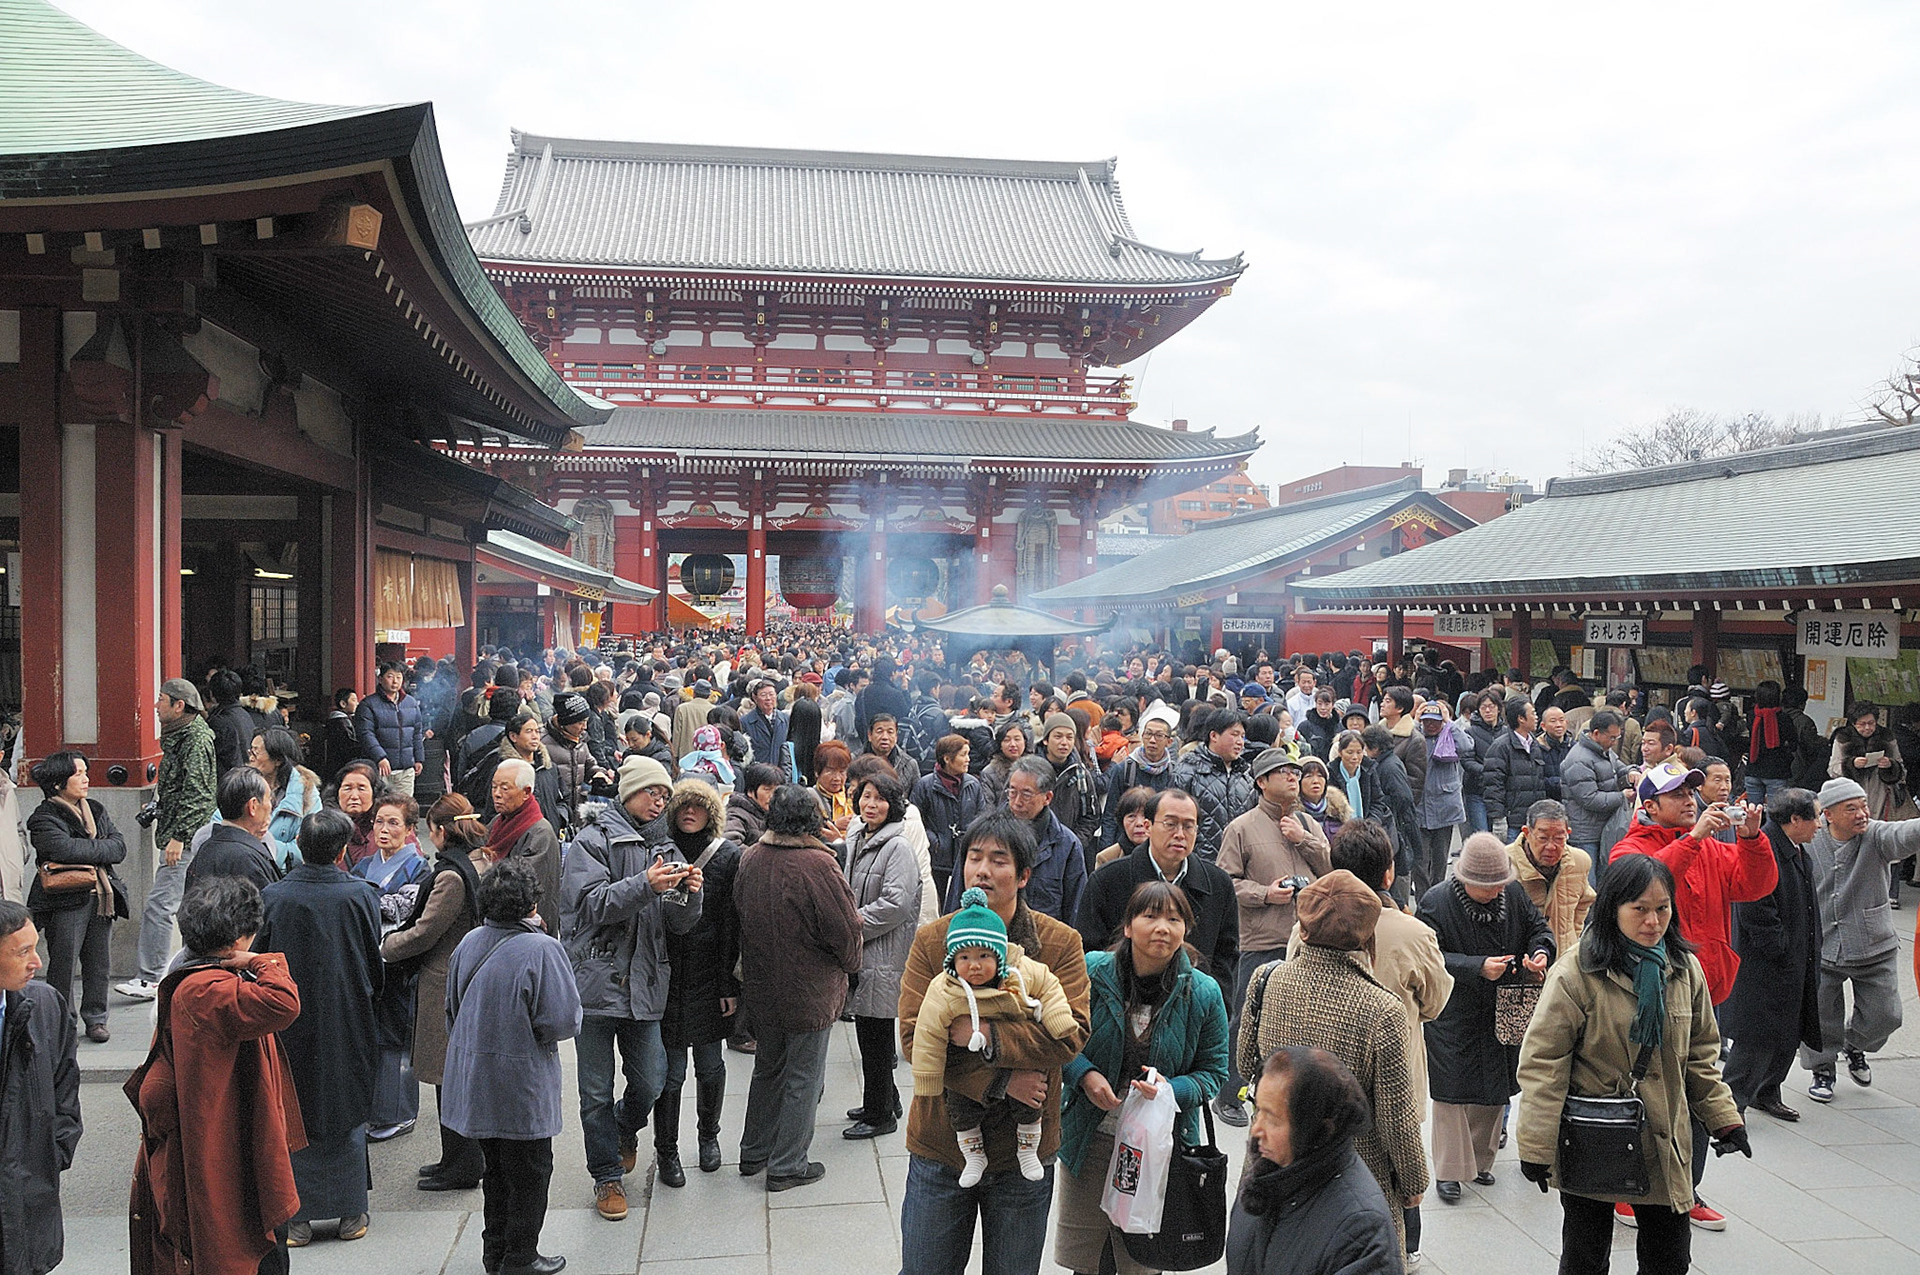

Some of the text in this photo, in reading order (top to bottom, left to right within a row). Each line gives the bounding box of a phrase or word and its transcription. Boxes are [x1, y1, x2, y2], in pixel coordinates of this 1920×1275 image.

[1223, 619, 1271, 631] 古札お納め所
[1439, 617, 1486, 634] 開運厄除お守
[1590, 622, 1641, 641] お札お守
[1805, 621, 1889, 648] 開運厄除
